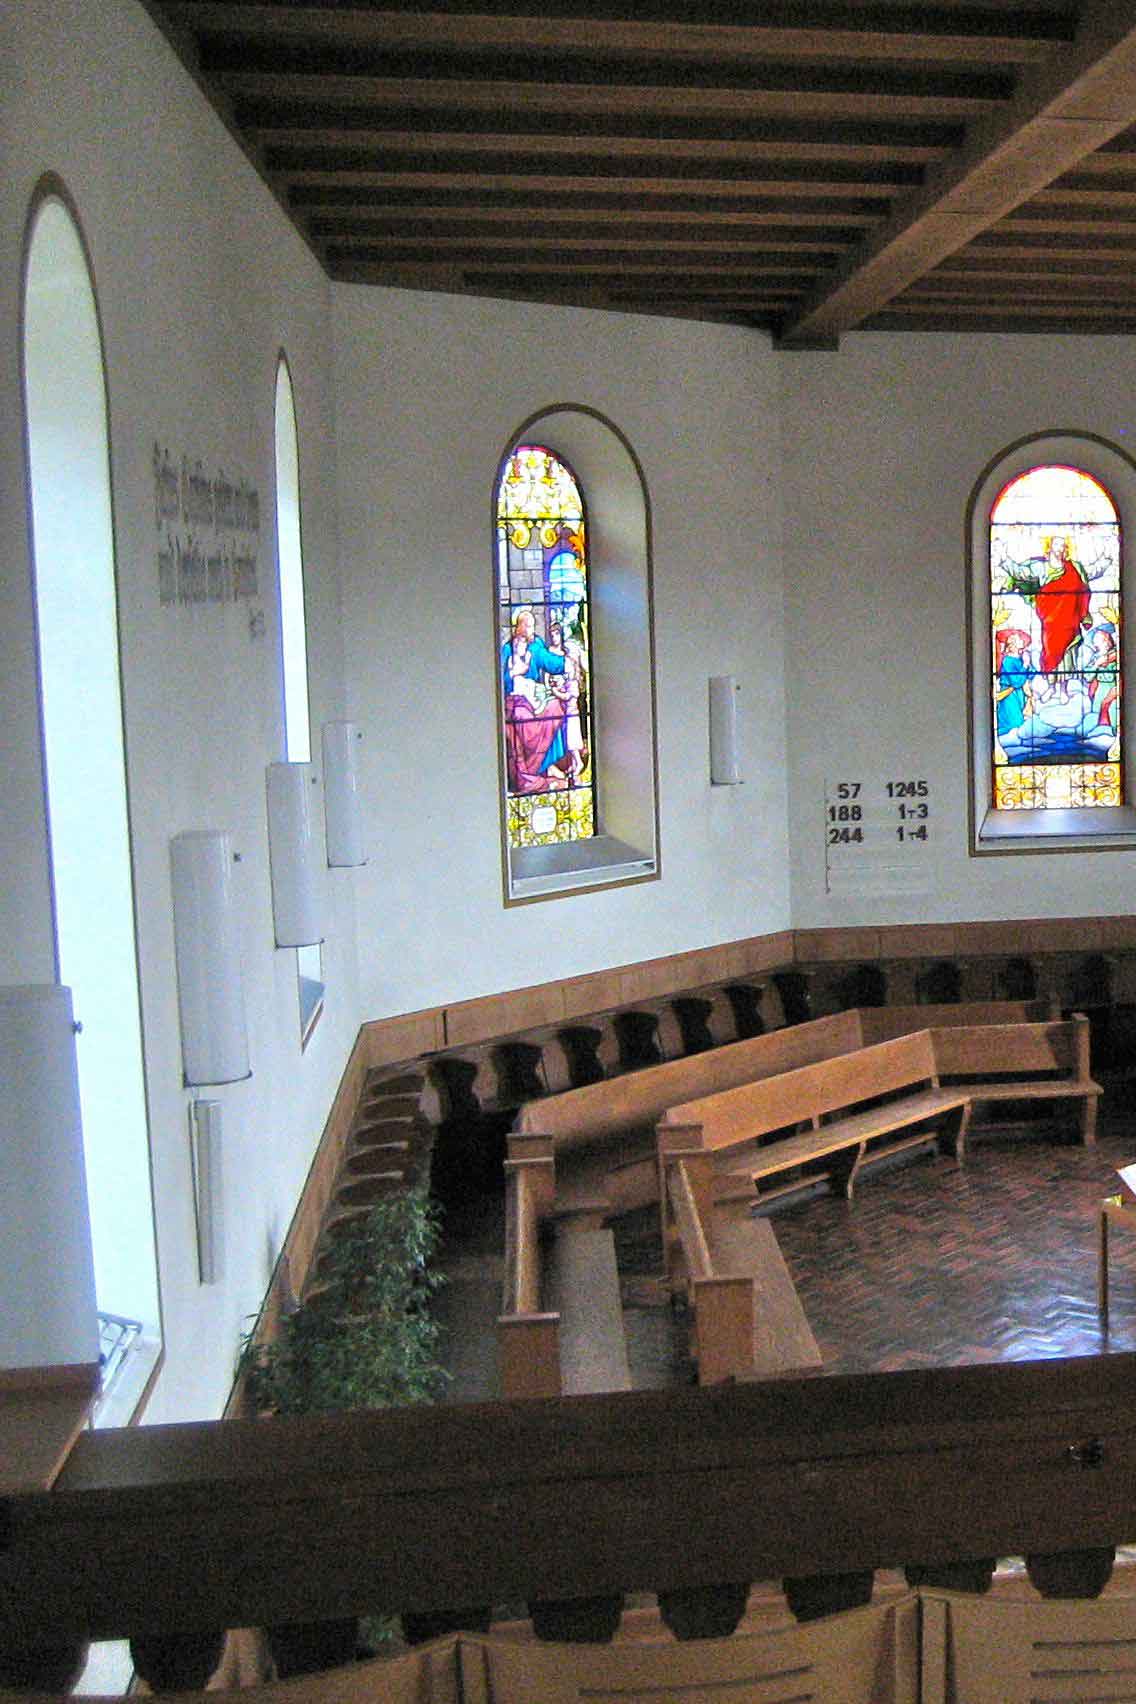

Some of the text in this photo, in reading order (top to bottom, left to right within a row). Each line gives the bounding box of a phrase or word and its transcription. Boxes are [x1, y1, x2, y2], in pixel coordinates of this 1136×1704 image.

[837, 781, 929, 799] 57 1245
[828, 805, 862, 821] 188
[828, 827, 864, 844] 244
